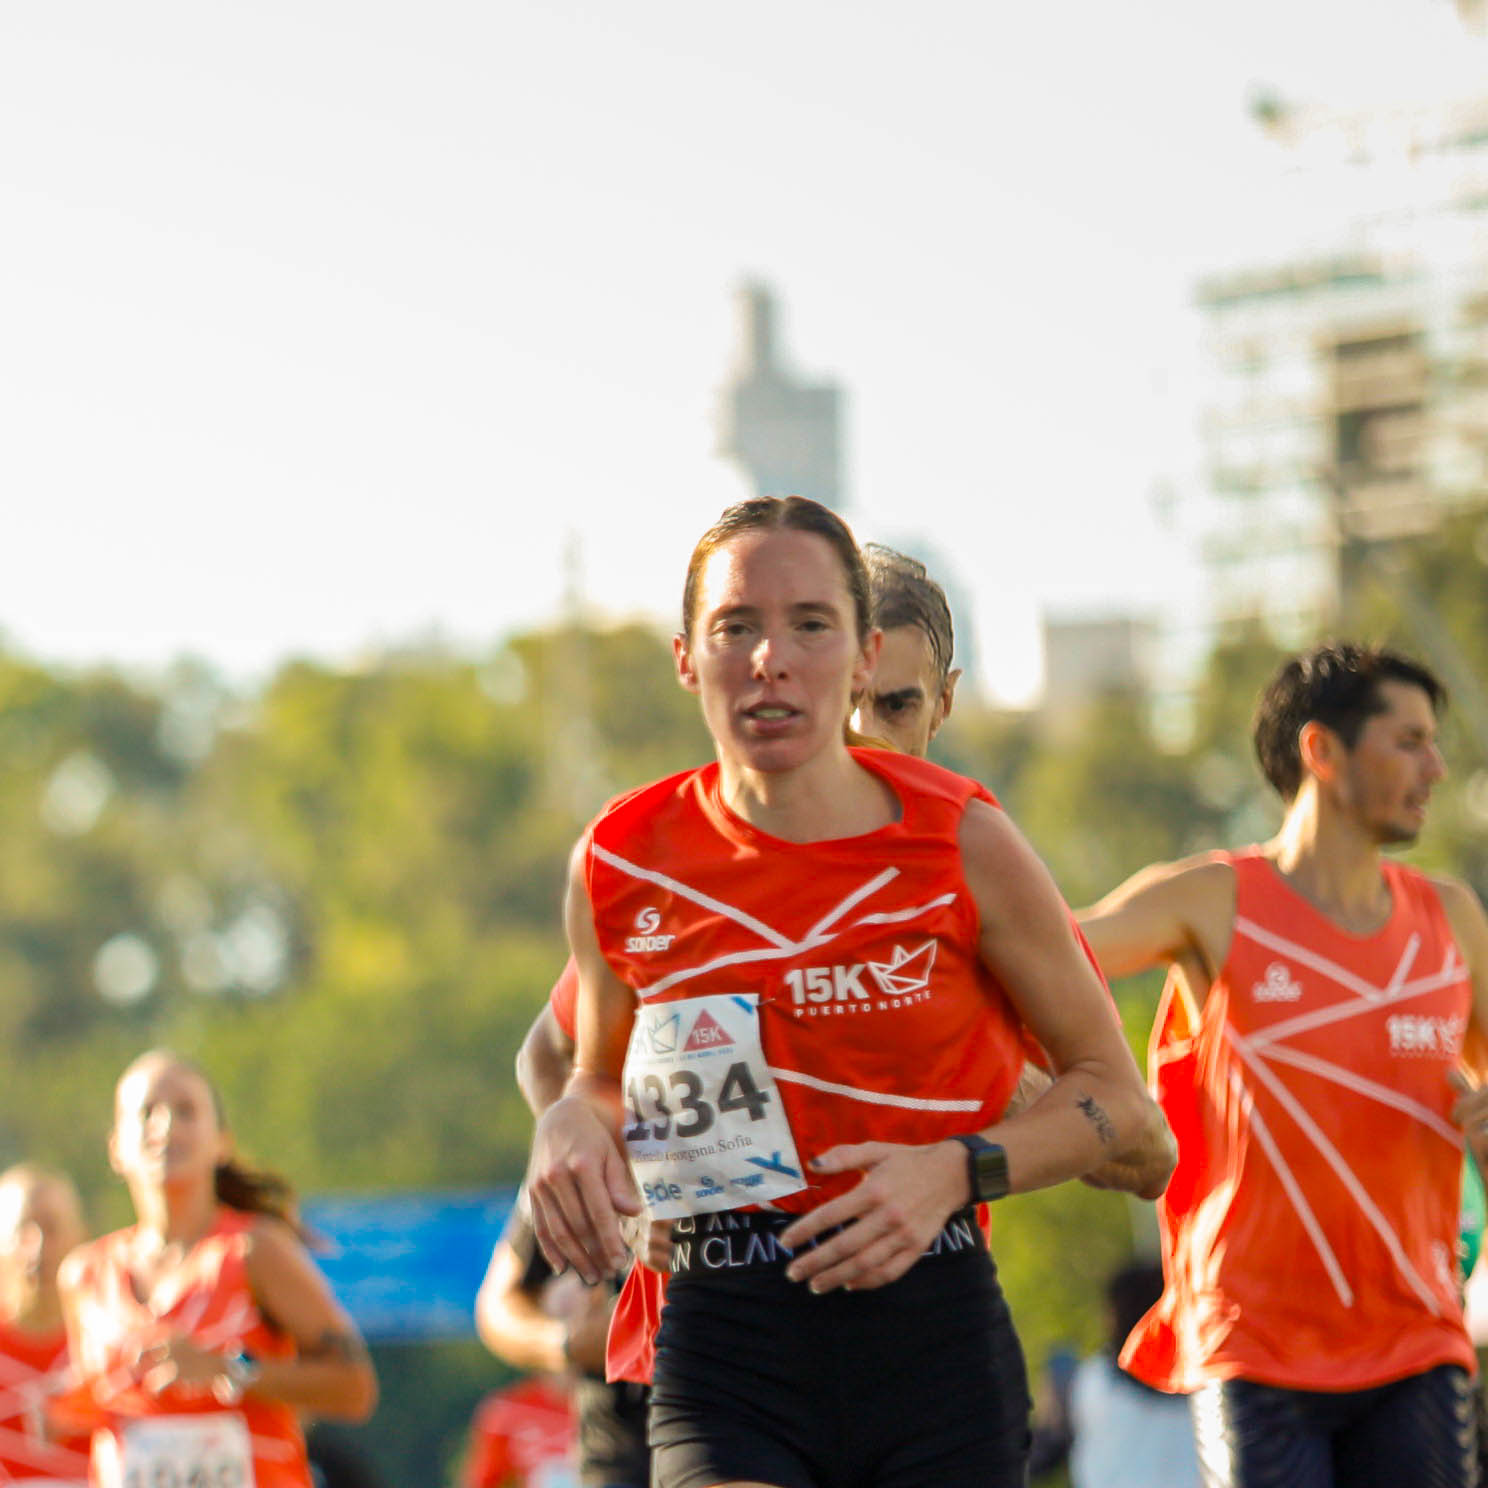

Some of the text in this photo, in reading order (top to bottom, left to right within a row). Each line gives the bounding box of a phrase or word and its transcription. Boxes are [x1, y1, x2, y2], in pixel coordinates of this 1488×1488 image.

[785, 963, 870, 1005] 15K
[795, 990, 931, 1018] PUERTO NORTE
[693, 1027, 722, 1044] 15K
[718, 1134, 753, 1153] Sofia
[642, 1177, 682, 1203] sde
[703, 1232, 794, 1268] CLAN
